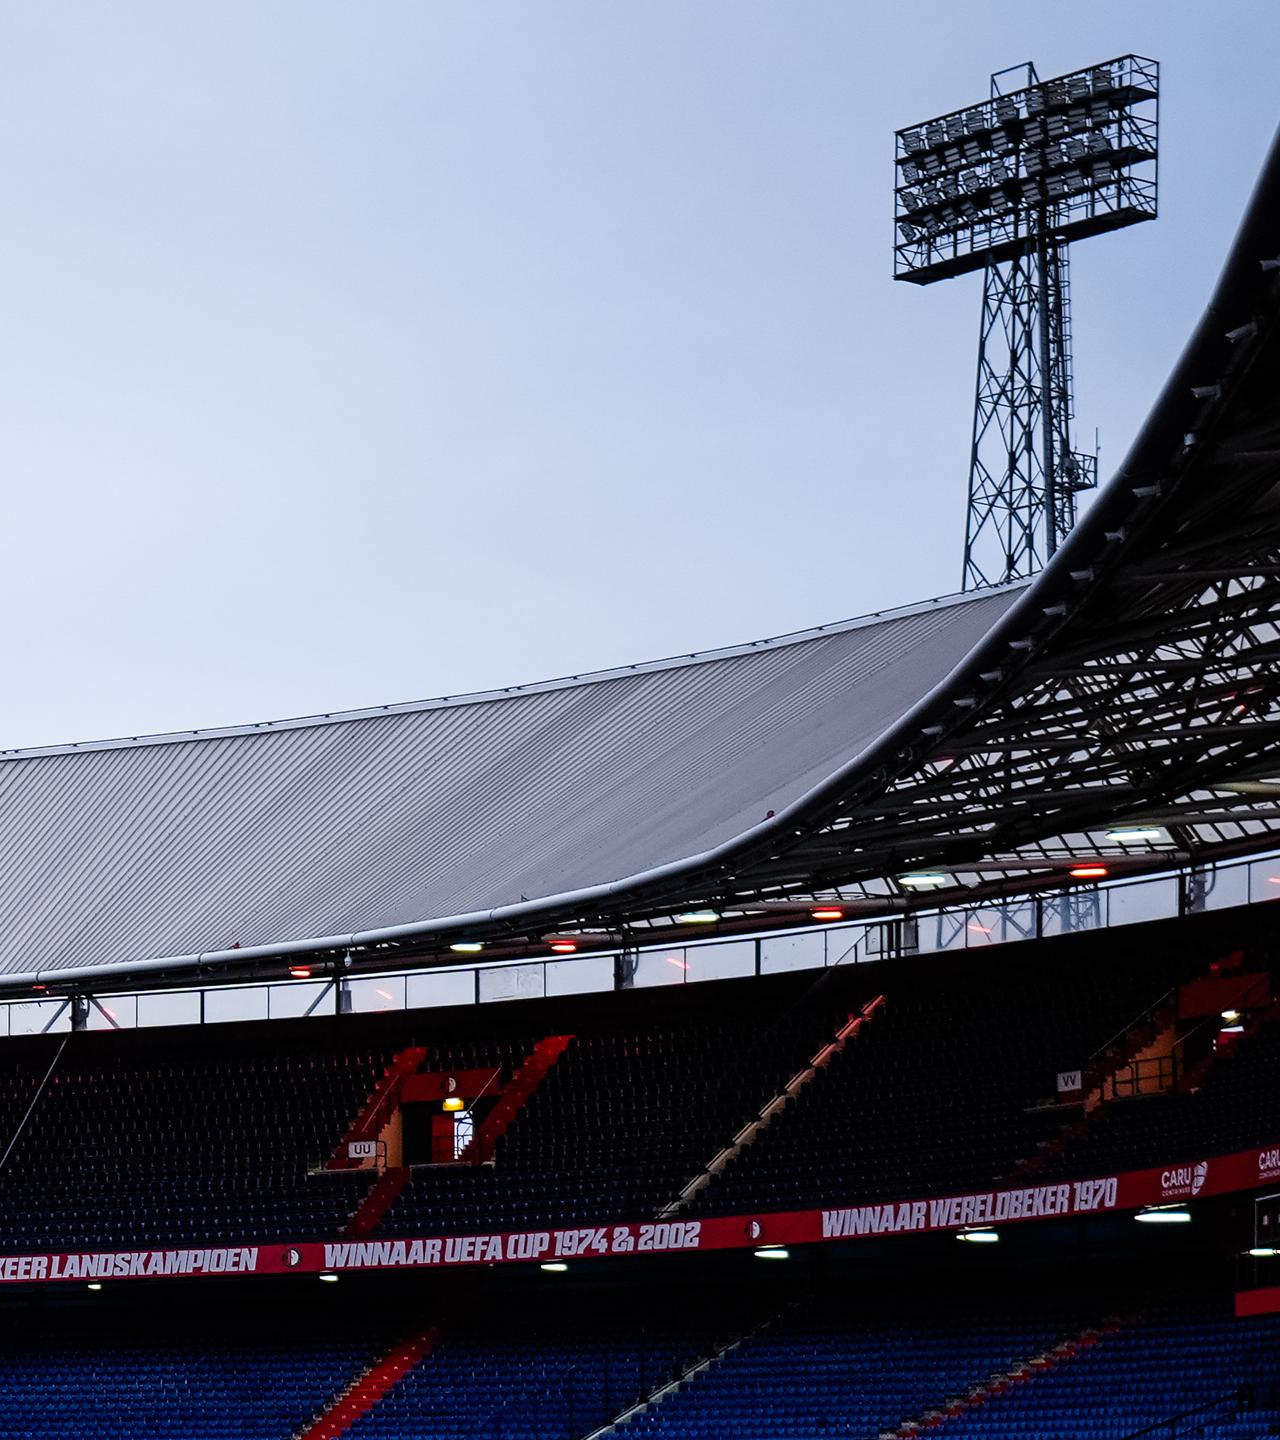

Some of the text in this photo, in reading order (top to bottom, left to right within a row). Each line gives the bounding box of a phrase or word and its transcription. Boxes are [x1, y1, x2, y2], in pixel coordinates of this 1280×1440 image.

[354, 1144, 371, 1154] UU
[1161, 1167, 1191, 1188] CARU
[822, 1177, 1118, 1238] WINNAAR WERELDBEKER 1970
[324, 1239, 442, 1269] WINNAAR
[444, 1236, 503, 1263] UEFA
[506, 1232, 549, 1260] CUP
[552, 1226, 608, 1257] 1974
[637, 1222, 702, 1250] 2002
[49, 1247, 259, 1279] LANDSKAMPIOEN
